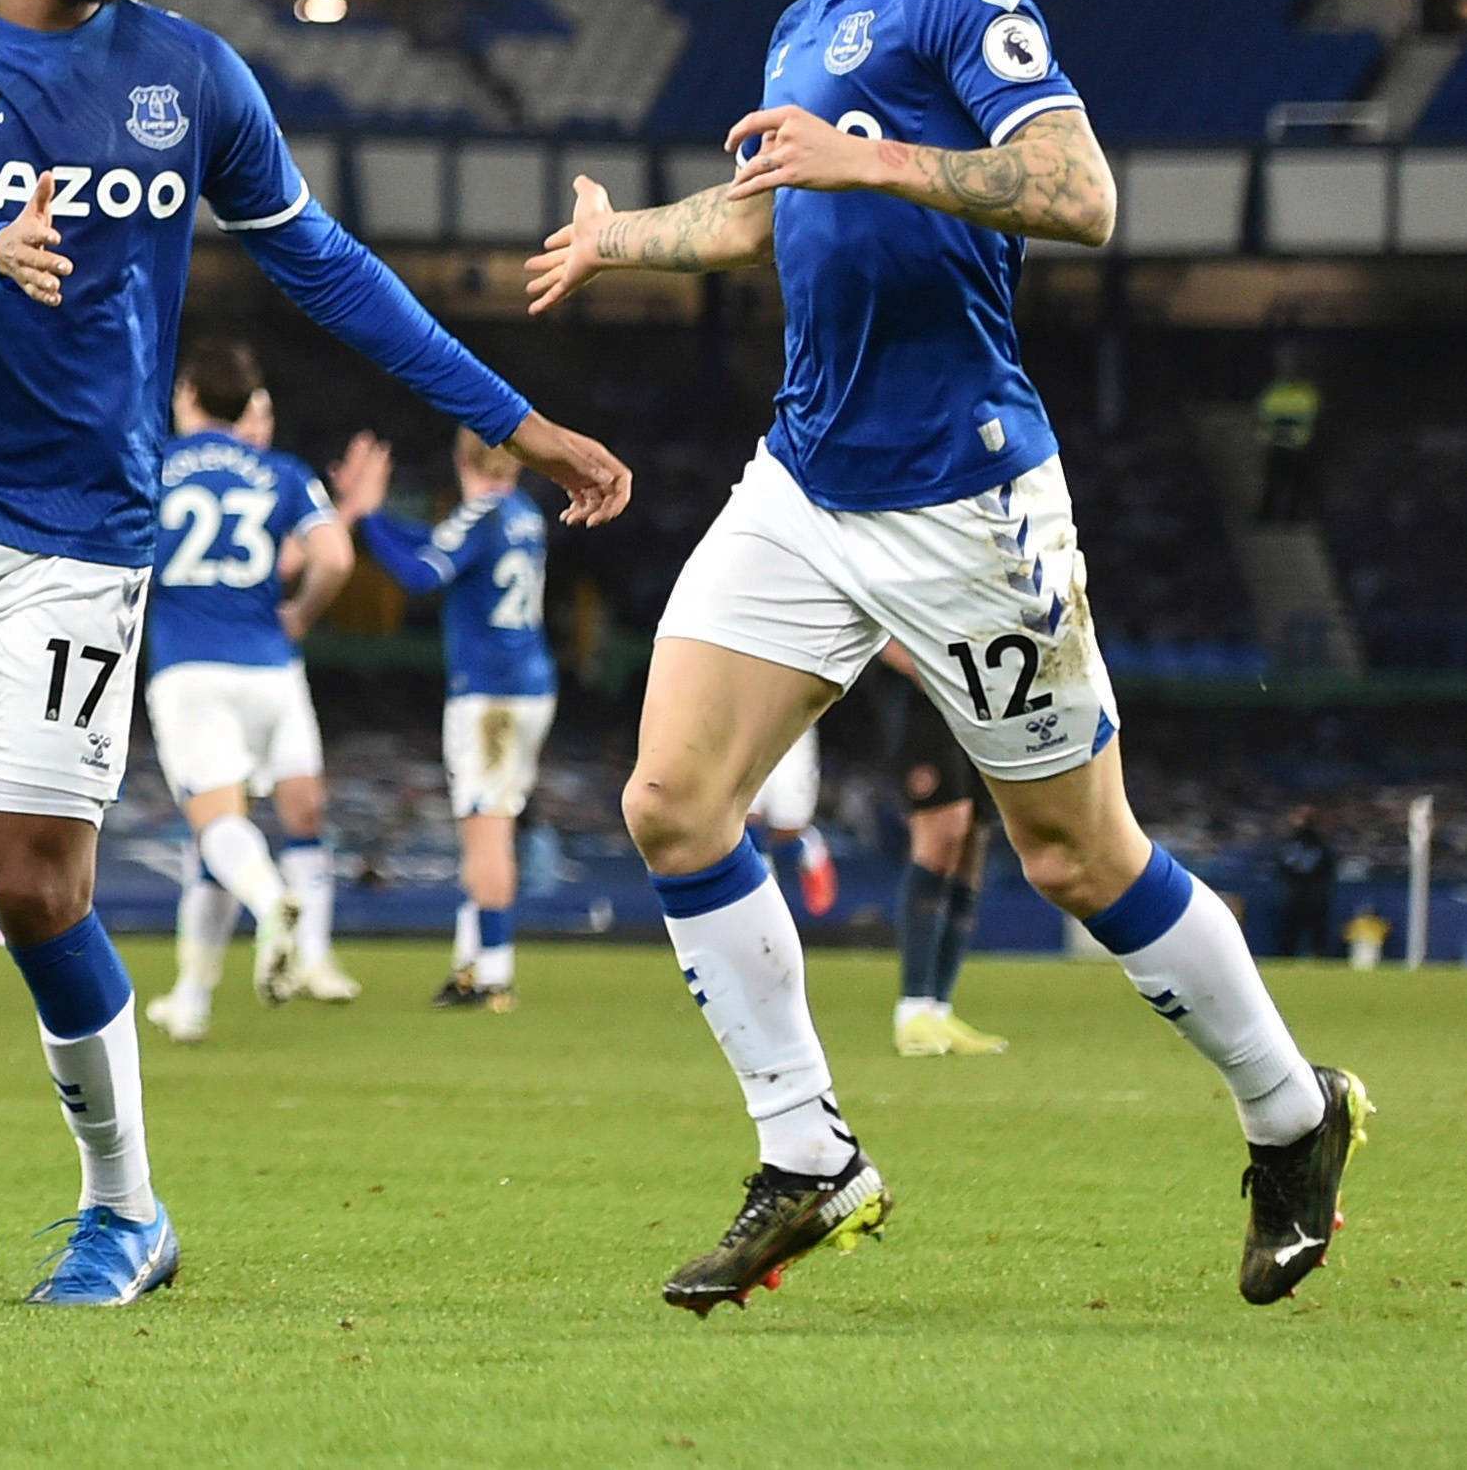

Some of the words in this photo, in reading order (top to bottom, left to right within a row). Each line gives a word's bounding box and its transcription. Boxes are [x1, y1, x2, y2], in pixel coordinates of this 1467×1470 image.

[159, 482, 279, 590] 23
[43, 637, 122, 730] 17
[947, 633, 1053, 721] 12
